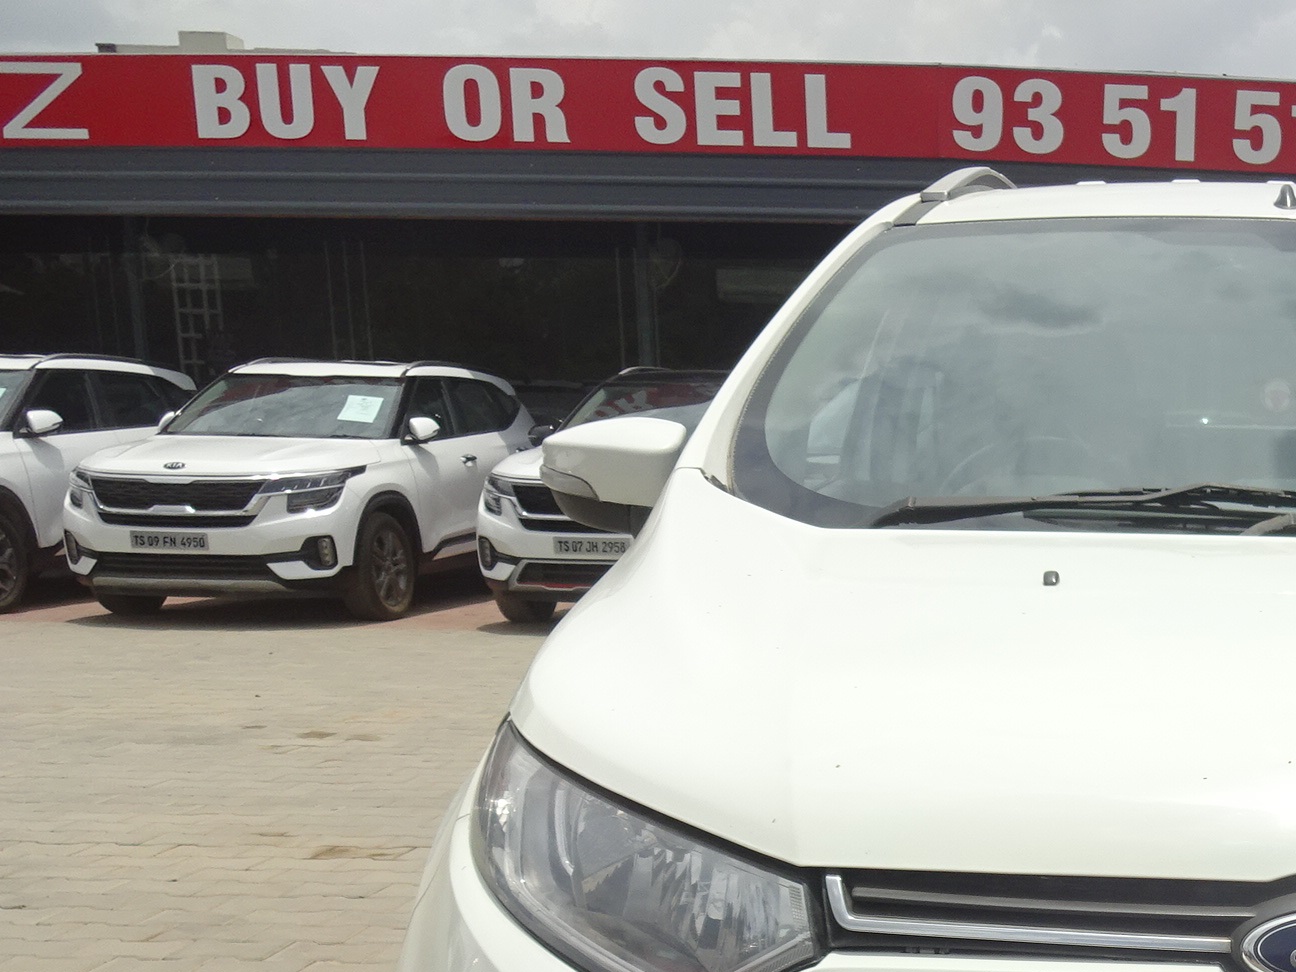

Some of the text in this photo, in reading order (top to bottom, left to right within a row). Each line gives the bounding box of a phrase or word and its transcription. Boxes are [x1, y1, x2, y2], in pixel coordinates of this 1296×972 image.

[191, 63, 380, 141] BUY
[442, 64, 571, 143] OR
[633, 66, 852, 149] SELL
[952, 75, 1064, 154] 93
[1101, 83, 1196, 162] 51
[133, 535, 205, 548] TS 09 FN 4950
[558, 541, 569, 552] TS
[571, 541, 583, 553] 07
[586, 541, 599, 553] JH
